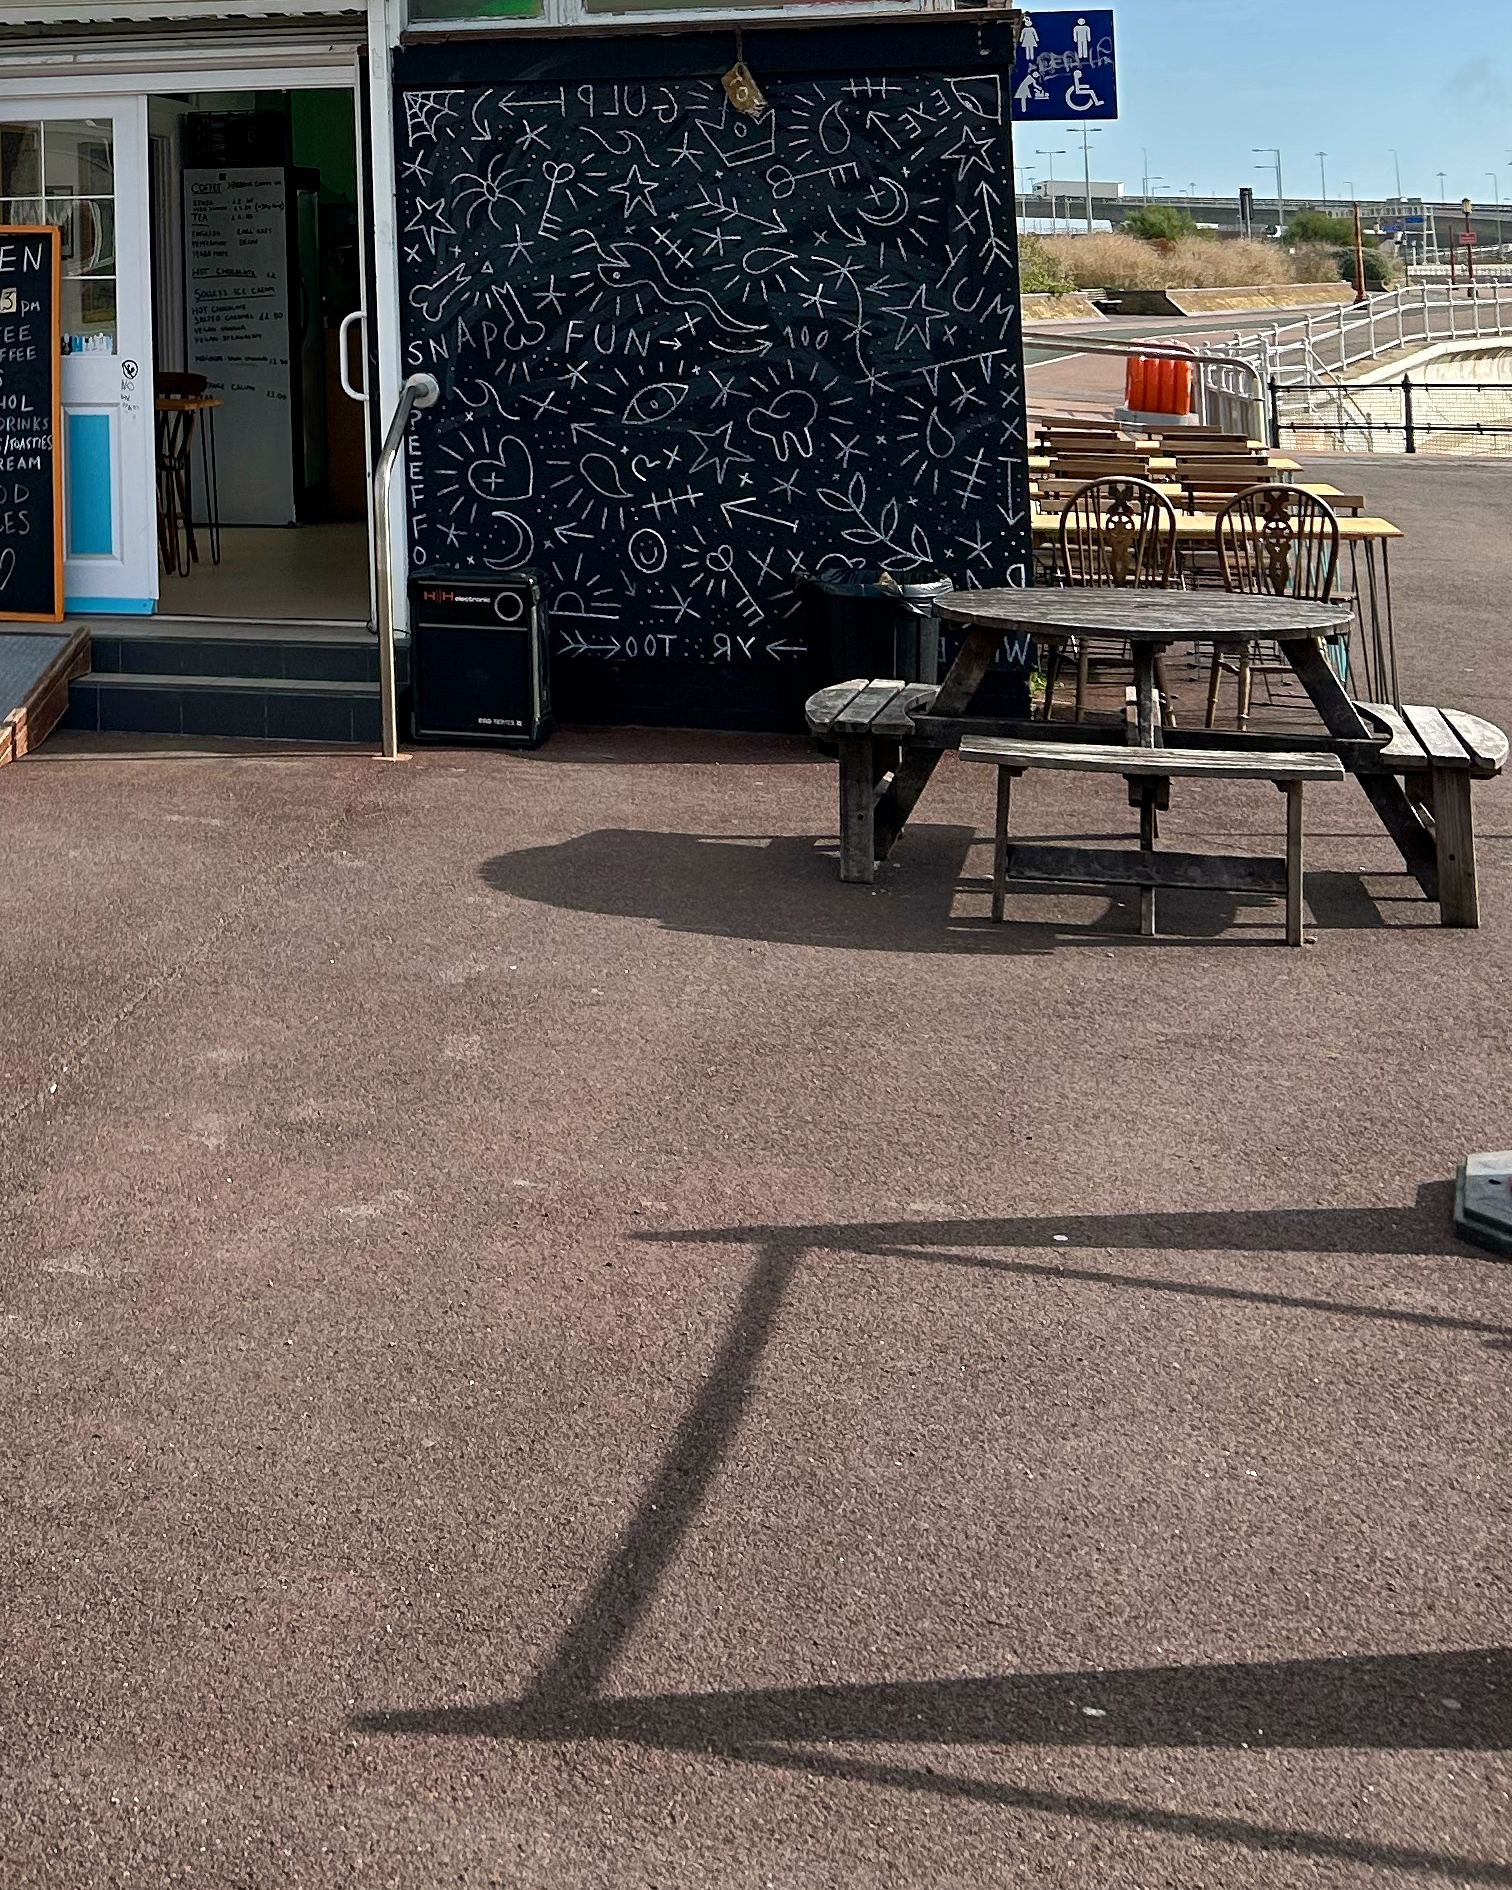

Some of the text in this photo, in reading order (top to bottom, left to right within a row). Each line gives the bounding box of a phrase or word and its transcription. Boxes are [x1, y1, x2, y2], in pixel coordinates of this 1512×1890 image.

[935, 244, 1015, 340] YUM
[407, 315, 651, 366] SNAP FUN
